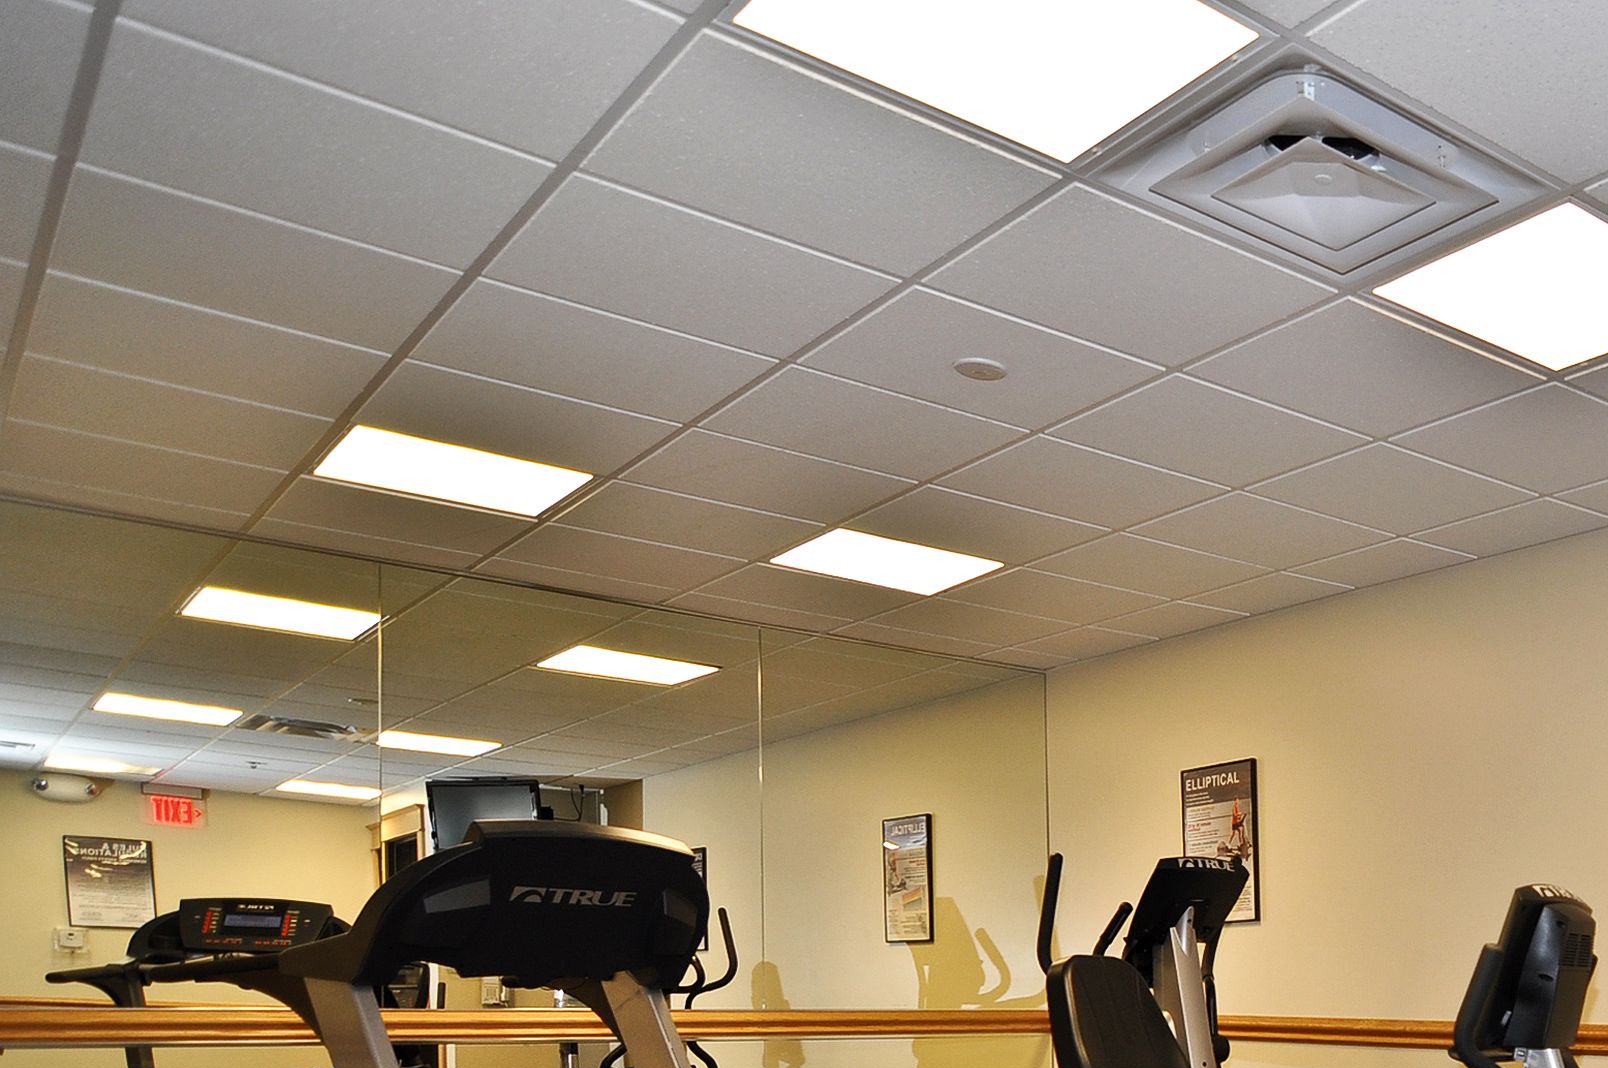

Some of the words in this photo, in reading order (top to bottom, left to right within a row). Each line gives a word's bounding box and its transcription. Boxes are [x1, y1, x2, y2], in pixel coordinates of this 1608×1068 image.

[1185, 771, 1240, 792] ELLIPTICAL
[1197, 858, 1236, 872] TRUE
[548, 887, 638, 907] TRUE
